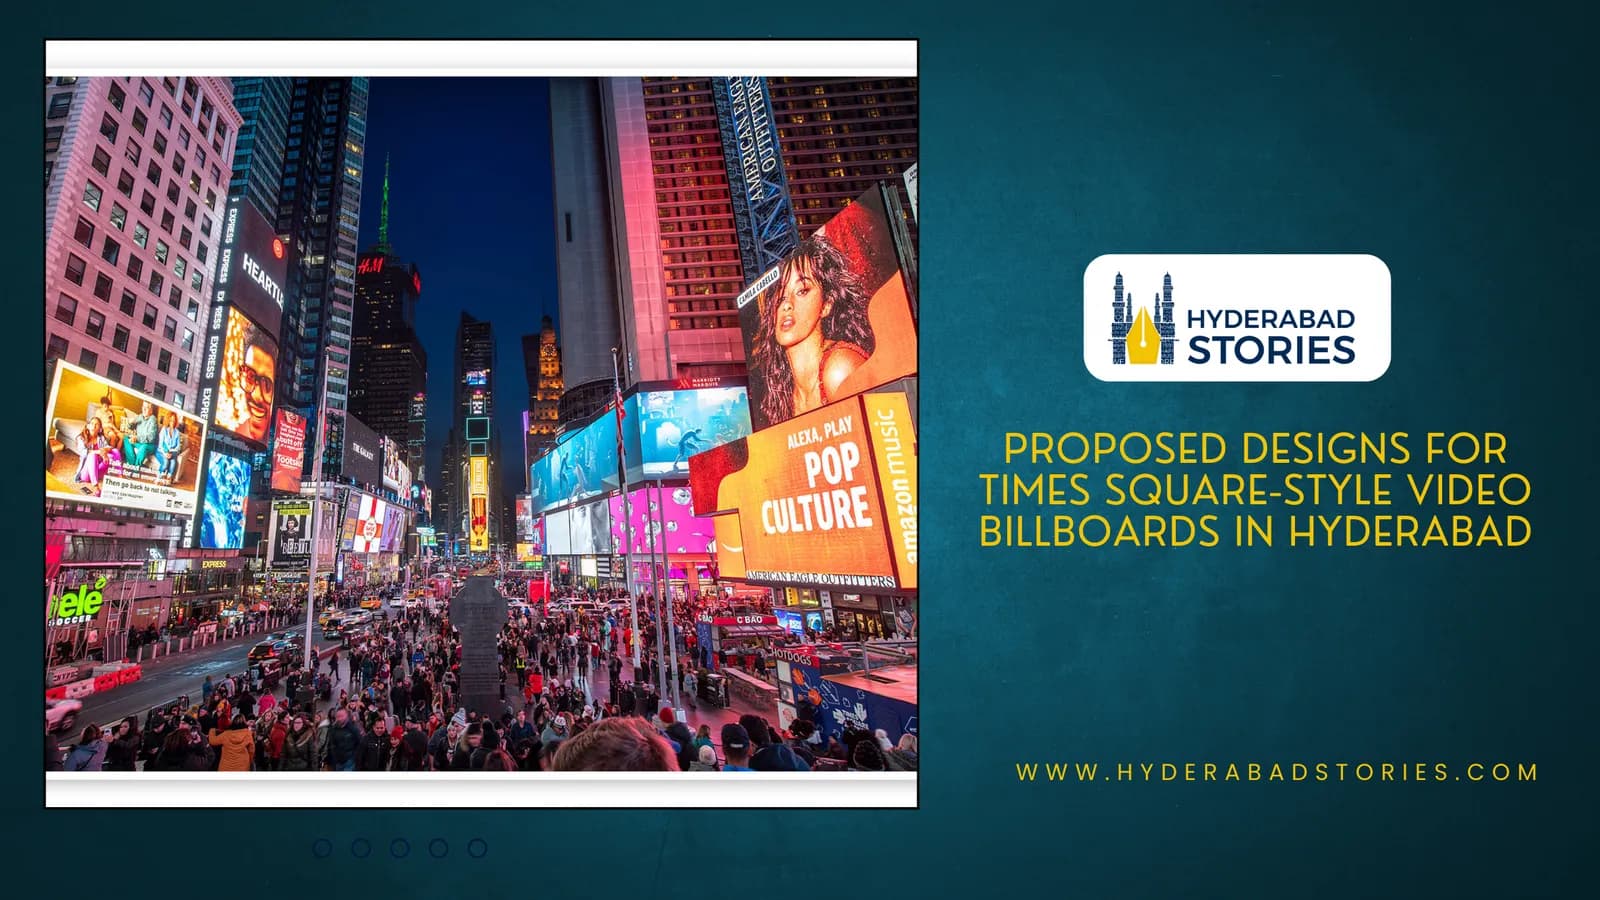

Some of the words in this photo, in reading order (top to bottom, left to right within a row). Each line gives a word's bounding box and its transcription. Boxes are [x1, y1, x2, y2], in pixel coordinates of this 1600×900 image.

[727, 76, 748, 116] EAGL
[746, 76, 776, 173] OUTFITTERS
[737, 117, 764, 201] AMERICAN
[219, 249, 232, 284] EXPRESS
[243, 252, 285, 313] HEARTL
[205, 336, 219, 379] EXPRESS
[788, 427, 824, 450] ALEXA,
[823, 415, 853, 439] PLAY
[873, 409, 905, 475] music
[105, 478, 121, 487] Then
[130, 482, 143, 490] back
[804, 441, 860, 488] POP
[761, 485, 873, 535] CULTURE
[892, 479, 918, 565] amazon
[202, 561, 227, 569] EXPRESS
[746, 570, 788, 582] AMERICAN
[789, 572, 821, 585] EAGLE
[820, 573, 897, 589] OUTFITTERS
[736, 616, 743, 624] C
[744, 616, 763, 624] BAO
[771, 648, 812, 666] HOTDOGS
